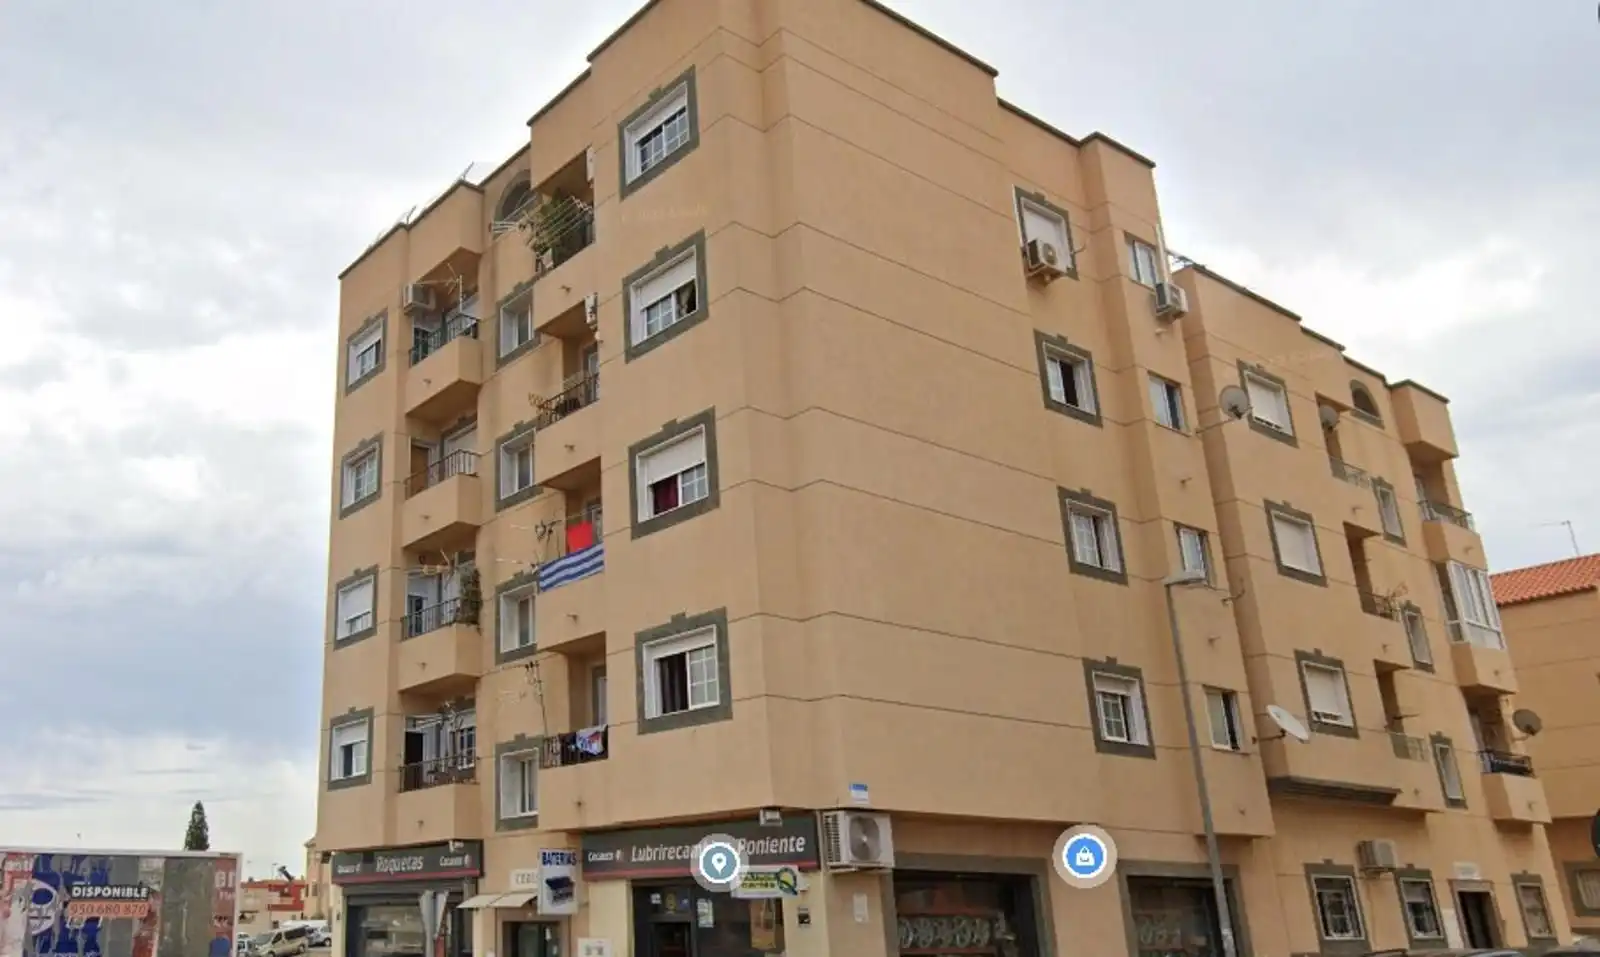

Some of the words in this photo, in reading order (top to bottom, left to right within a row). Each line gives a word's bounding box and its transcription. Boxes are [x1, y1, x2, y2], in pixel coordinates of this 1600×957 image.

[737, 835, 806, 855] Poniente
[375, 856, 424, 875] Roquetas
[72, 886, 148, 898] DISPONIBLE
[70, 903, 94, 915] 950
